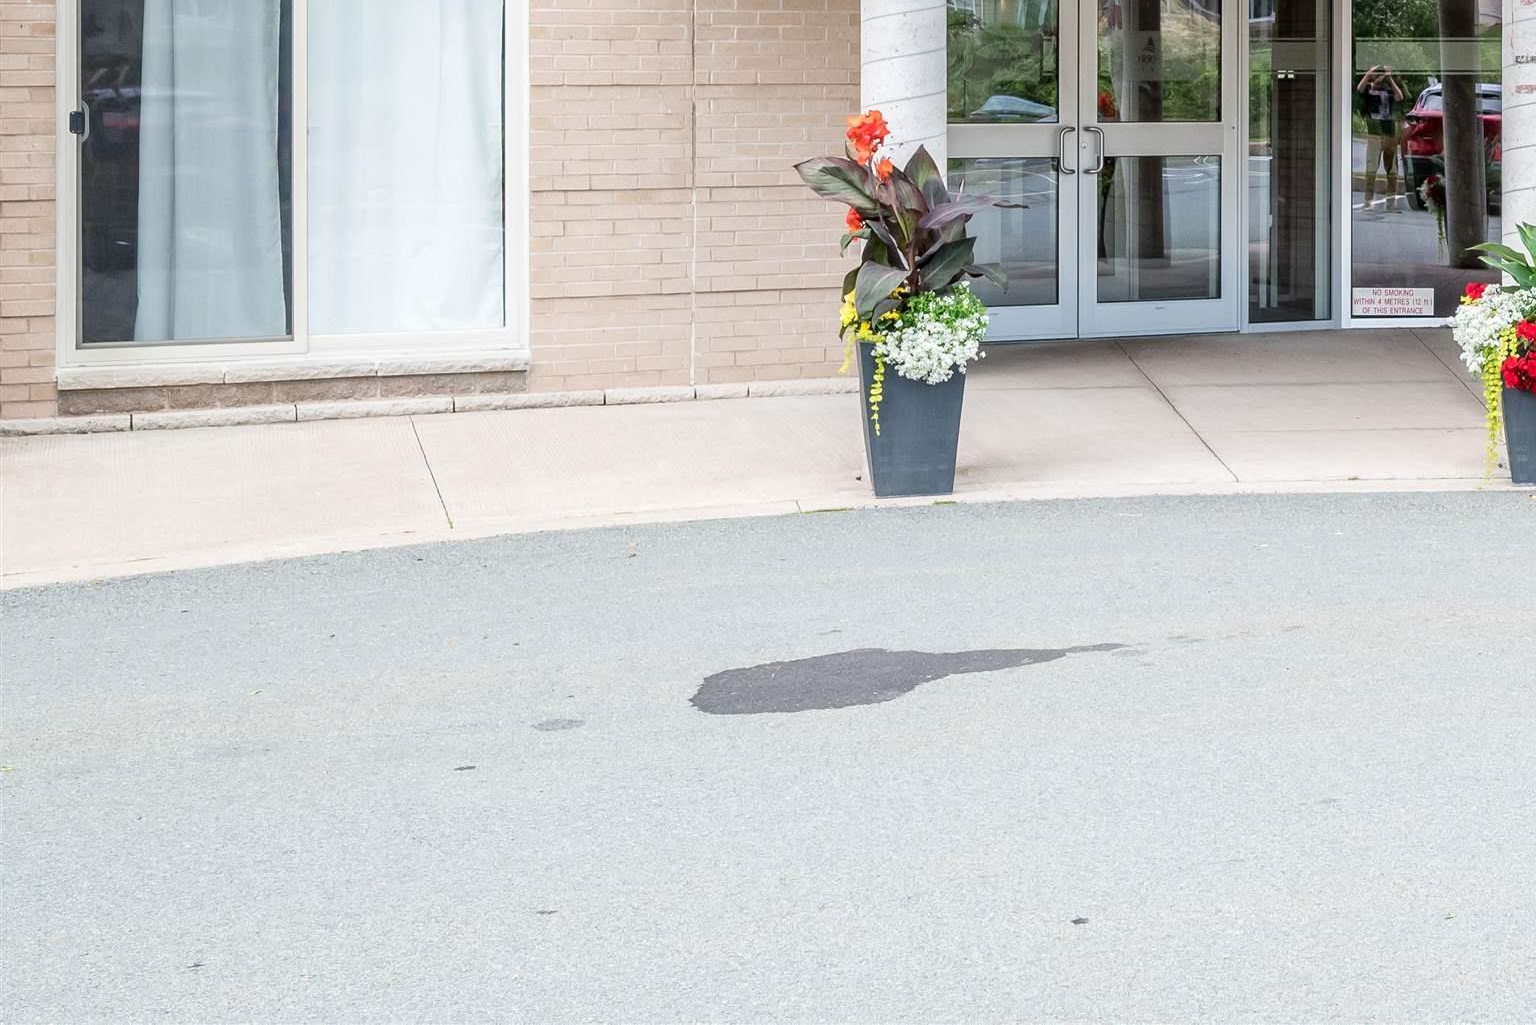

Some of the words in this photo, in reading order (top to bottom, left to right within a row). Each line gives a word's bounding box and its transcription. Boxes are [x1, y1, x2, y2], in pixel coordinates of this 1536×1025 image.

[1362, 306, 1371, 314] OF
[1373, 306, 1388, 314] THIS
[1389, 306, 1424, 314] ENTRANCE
